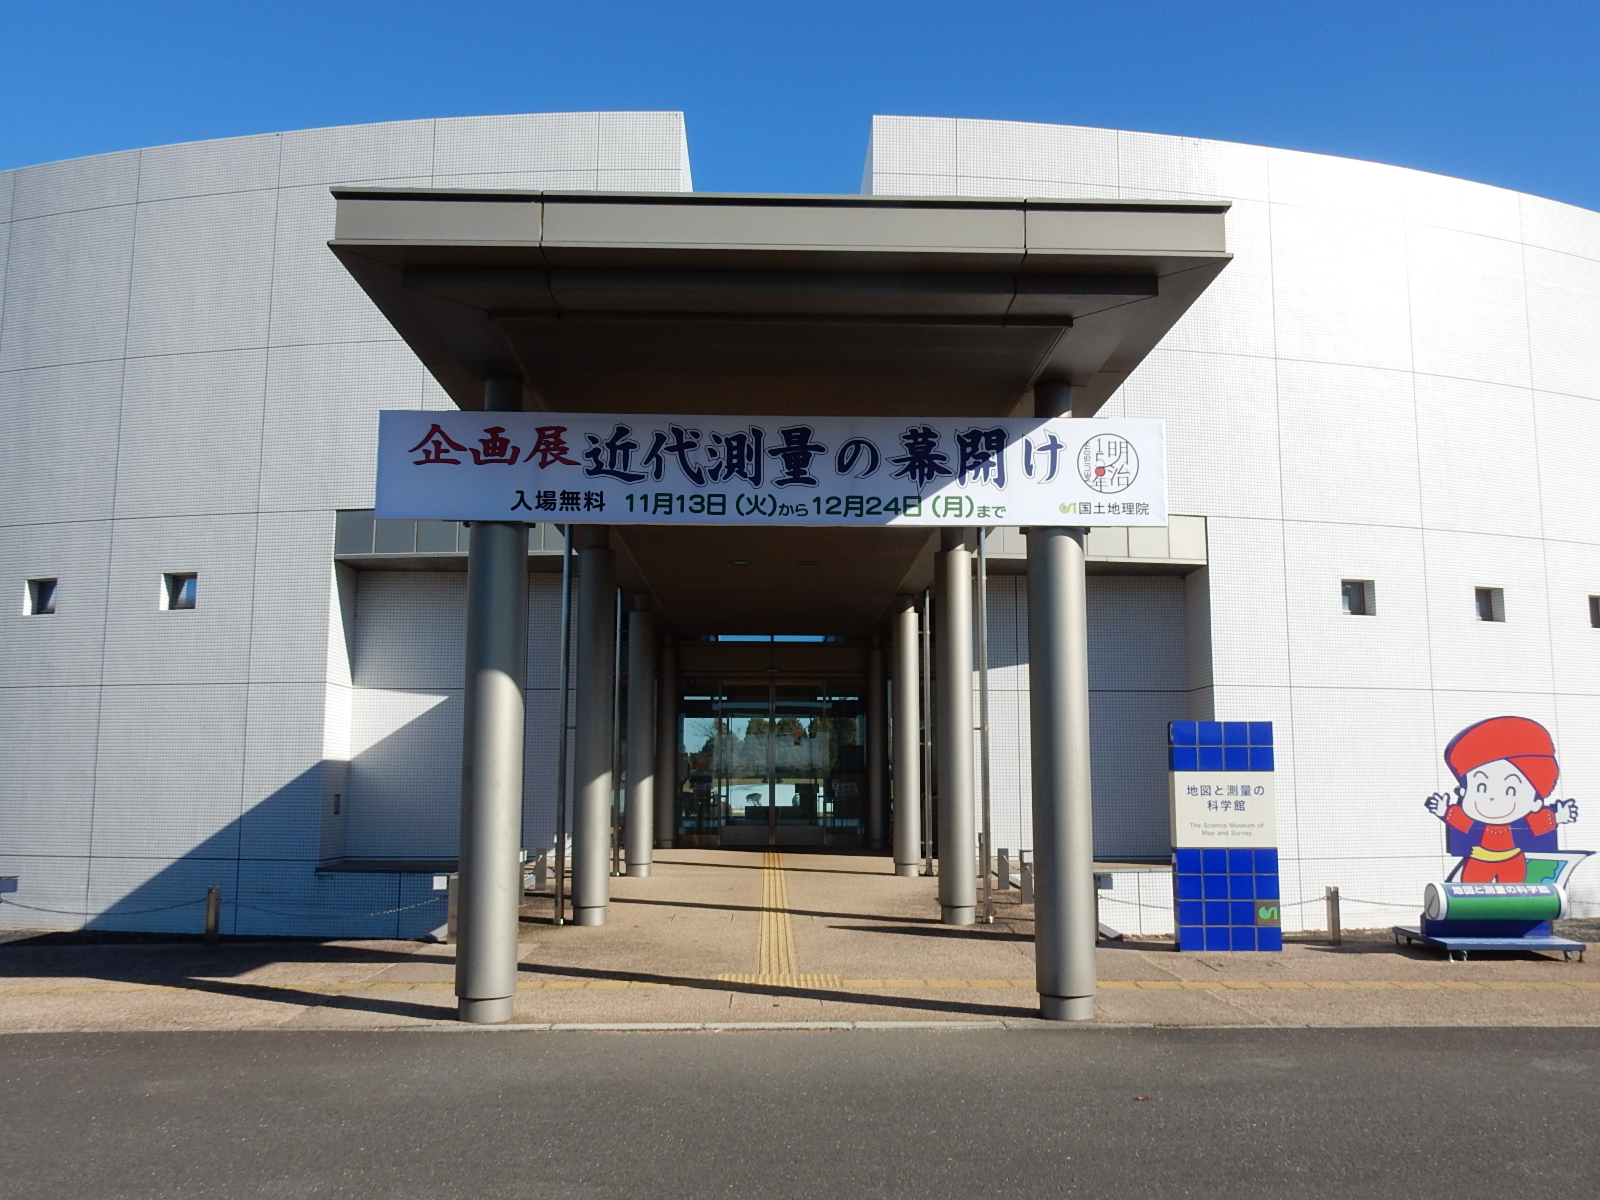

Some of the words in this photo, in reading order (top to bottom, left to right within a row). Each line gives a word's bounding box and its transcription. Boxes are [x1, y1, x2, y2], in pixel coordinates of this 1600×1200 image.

[408, 423, 582, 469] 企画展
[583, 423, 1067, 491] 近代測量の幕開け
[510, 490, 606, 512] 入場無料
[1079, 502, 1150, 515] 国土地理院
[1187, 785, 1265, 796] 地図と測量の
[1207, 800, 1246, 811] 科学館
